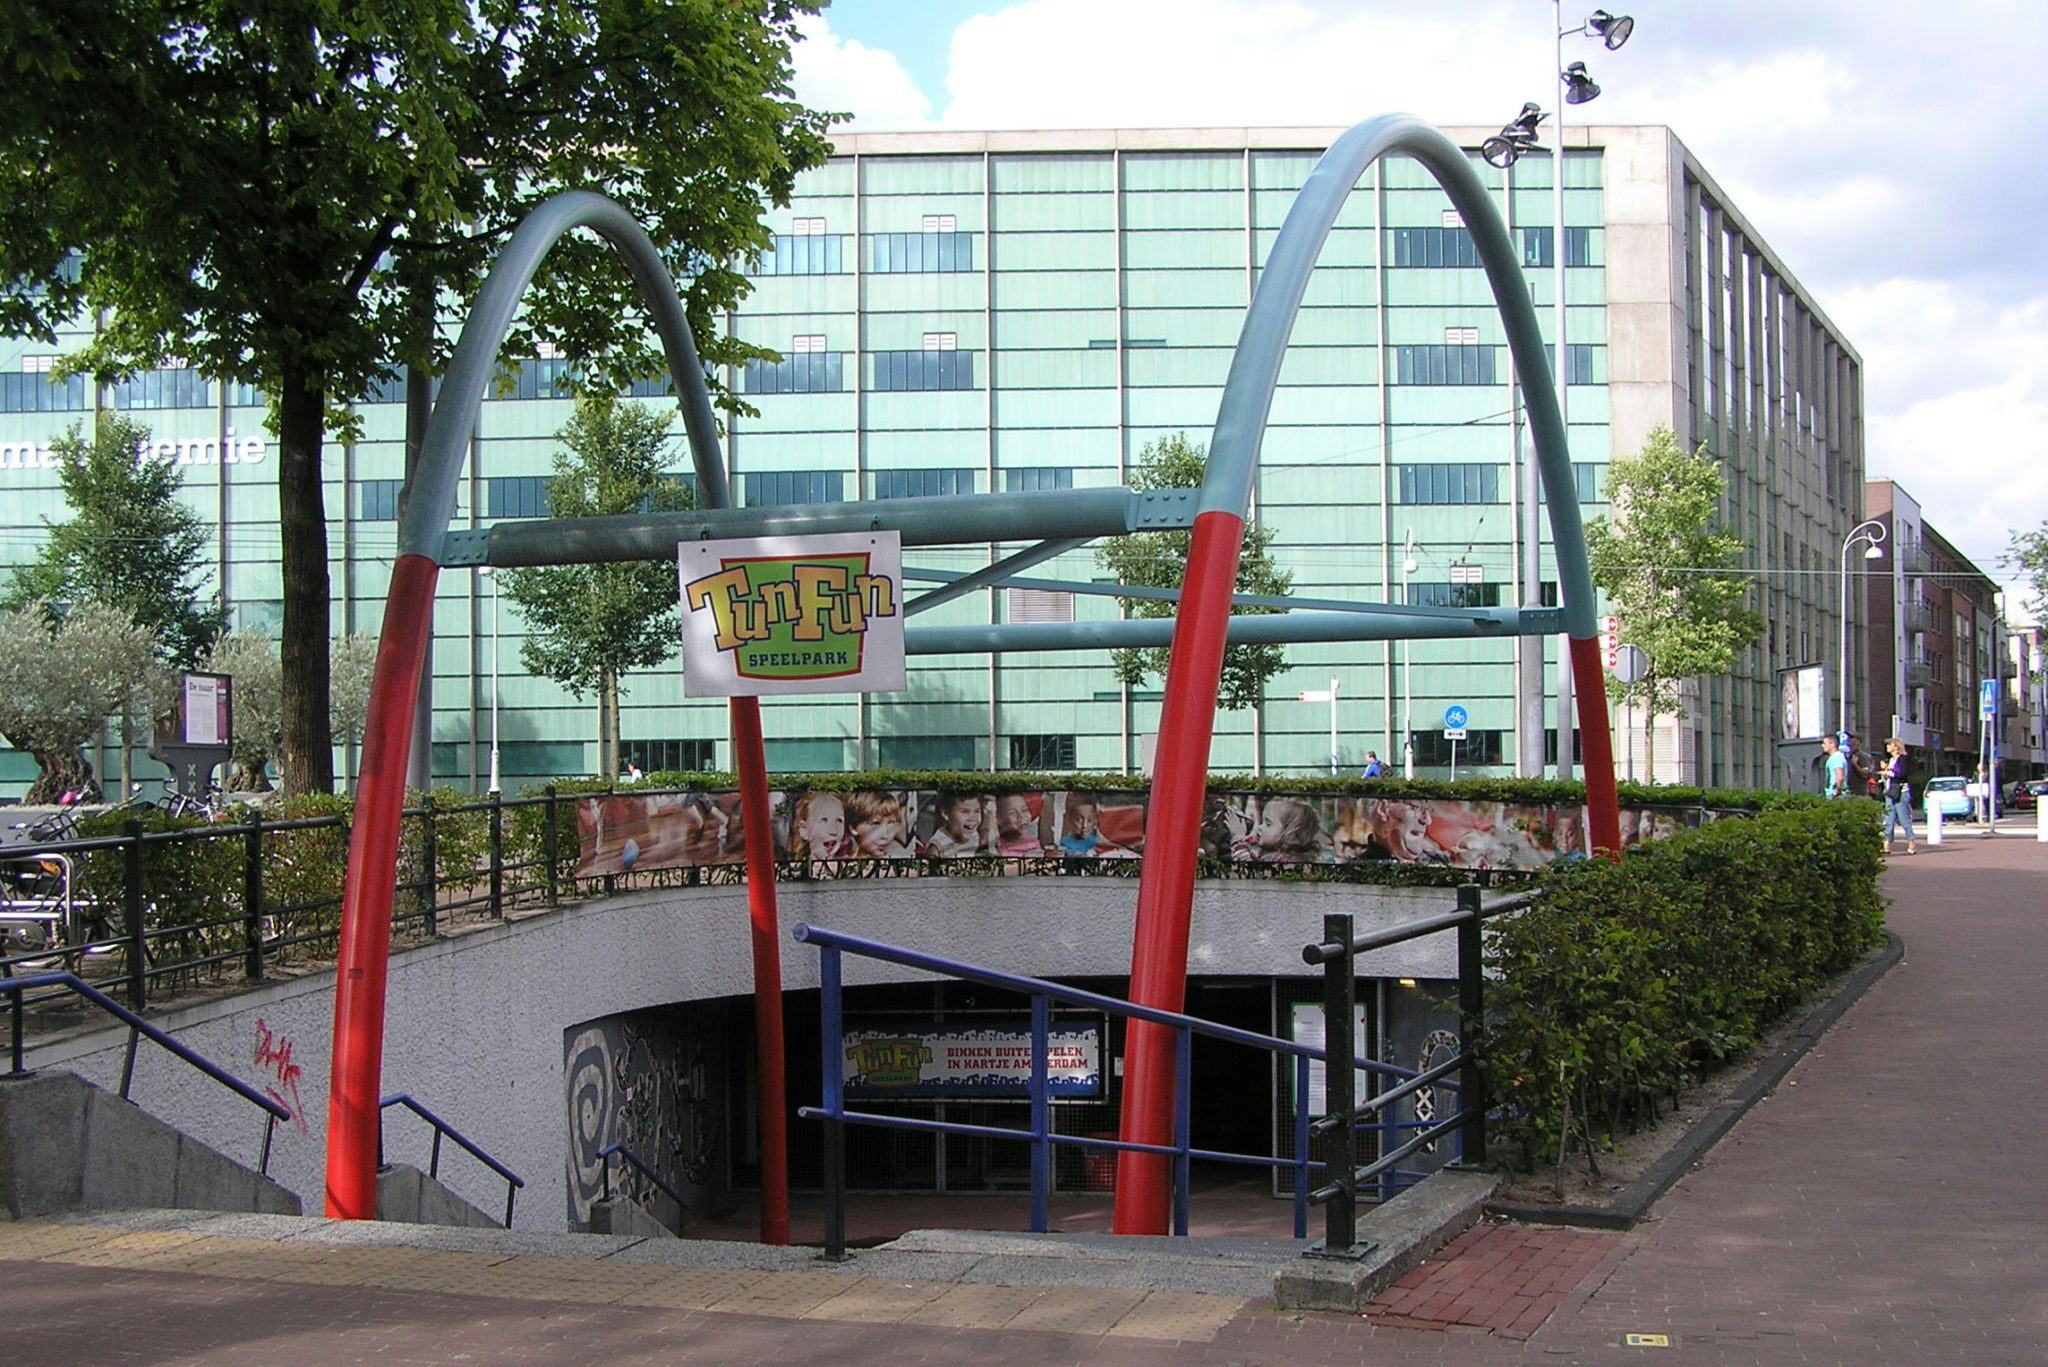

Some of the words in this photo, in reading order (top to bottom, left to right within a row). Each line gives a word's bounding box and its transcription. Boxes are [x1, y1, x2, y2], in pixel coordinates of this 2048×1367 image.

[685, 564, 895, 652] TunFun
[749, 652, 848, 667] SPEELPARK
[845, 1042, 933, 1075] TunFun
[947, 1047, 992, 1057] BINNEN
[996, 1047, 1084, 1057] BUITEPELEN
[947, 1059, 960, 1069] IN
[964, 1059, 1009, 1069] HARTJE
[1013, 1059, 1088, 1069] AMERDAM
